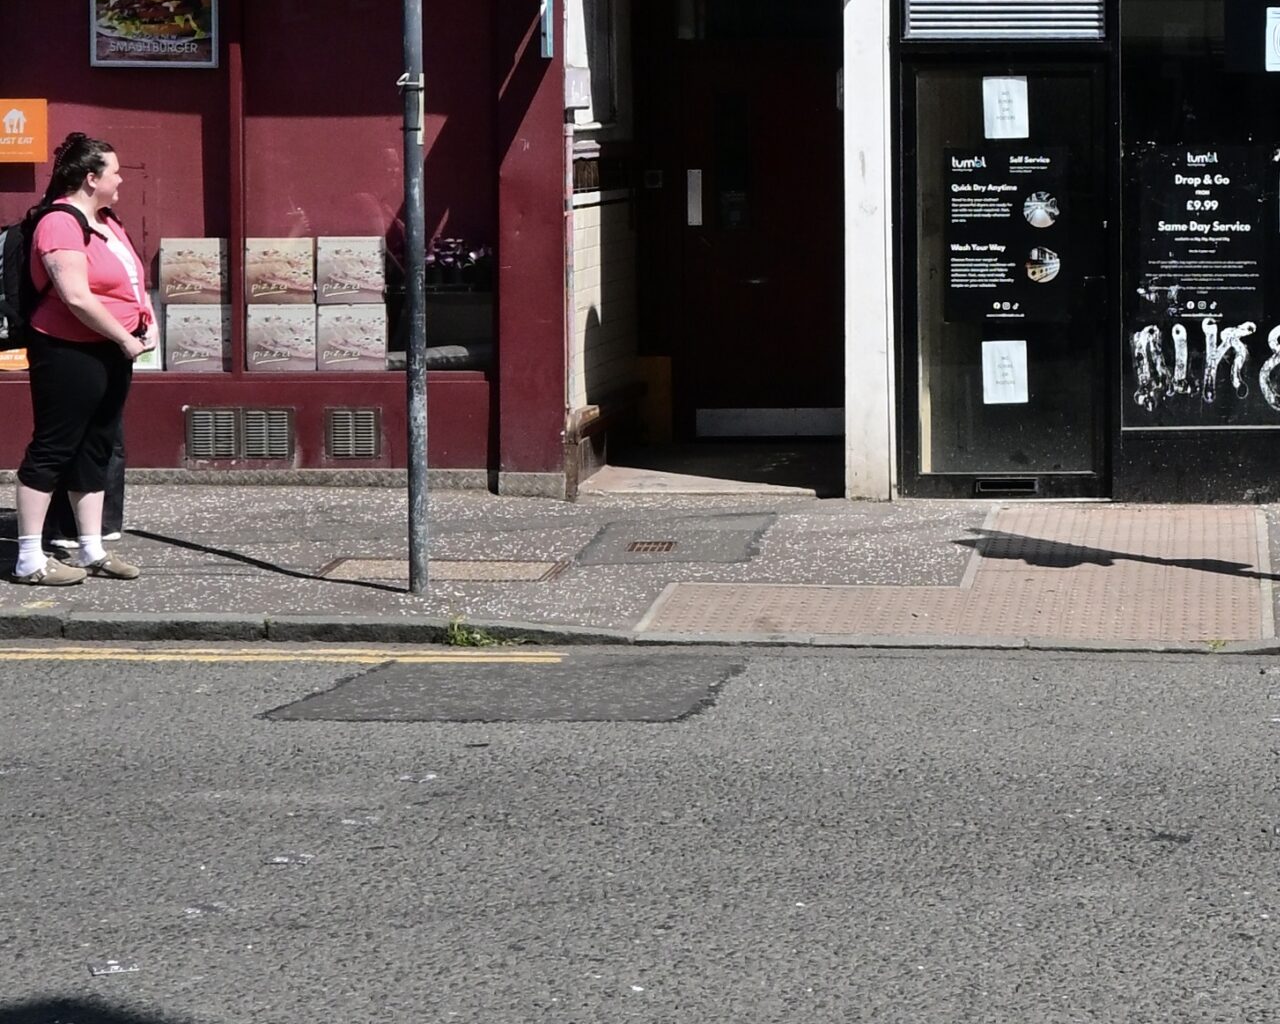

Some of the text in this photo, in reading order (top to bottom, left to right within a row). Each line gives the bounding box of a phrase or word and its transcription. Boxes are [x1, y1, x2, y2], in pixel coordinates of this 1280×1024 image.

[152, 41, 198, 54] BURGER
[1024, 156, 1051, 164] Service
[1174, 174, 1230, 187] Drop & Go
[951, 183, 1018, 193] Quick Dry Anytime
[1186, 200, 1219, 211] £9.99
[1158, 220, 1251, 234] Same Day Service
[951, 244, 1006, 253] Wash Your Way
